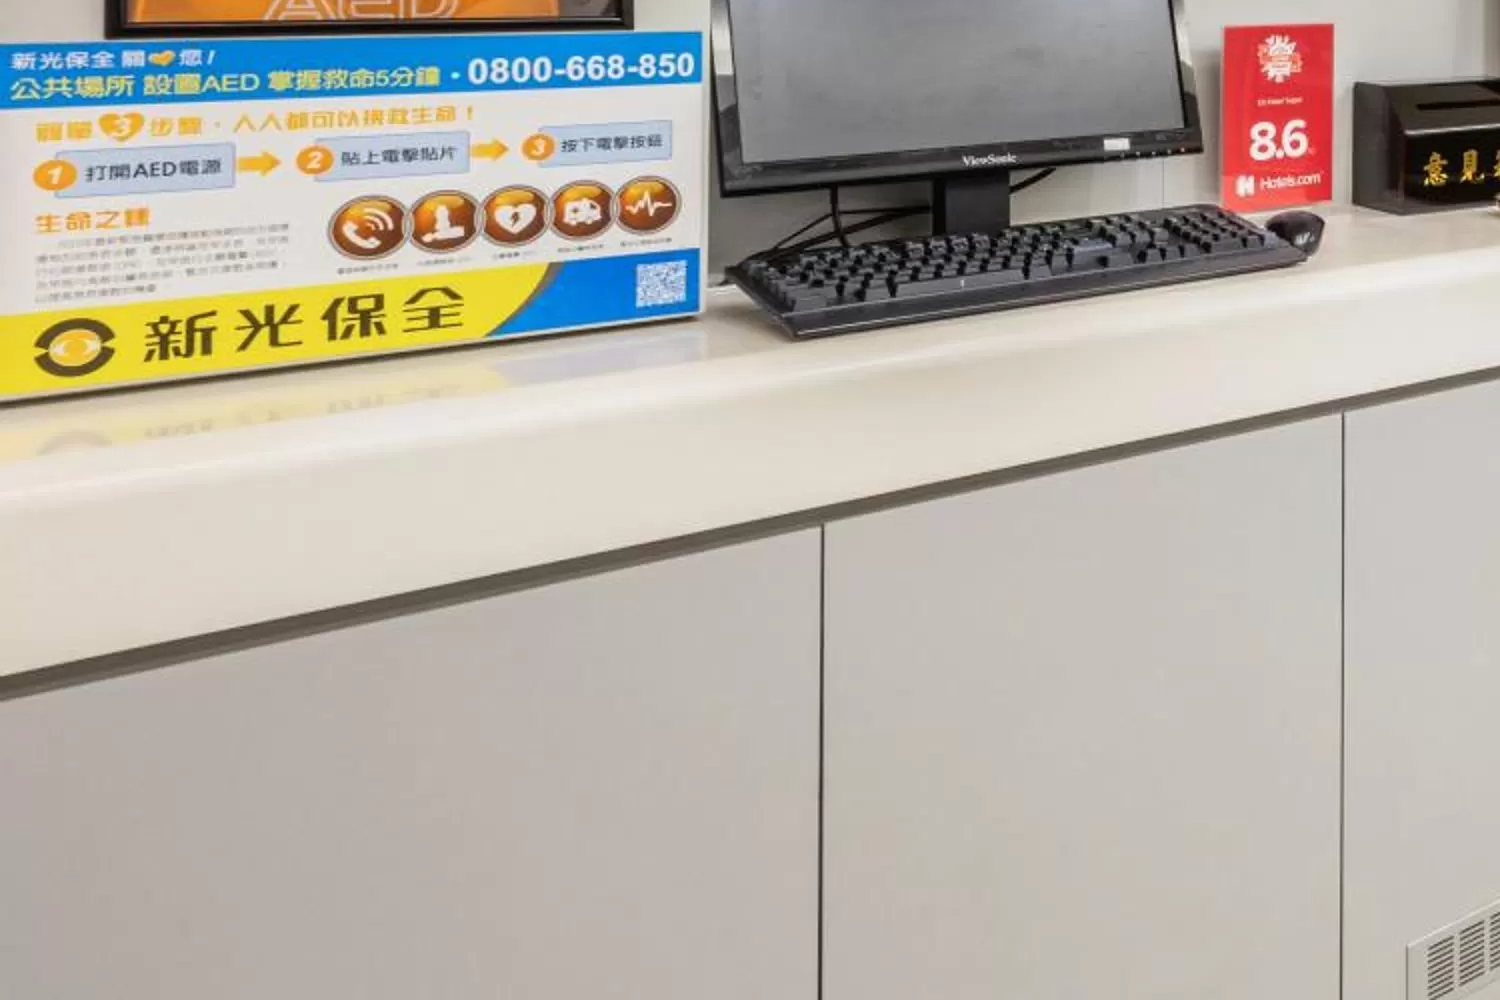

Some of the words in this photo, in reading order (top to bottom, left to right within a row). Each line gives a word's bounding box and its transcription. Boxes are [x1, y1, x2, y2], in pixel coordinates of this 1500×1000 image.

[10, 50, 116, 71] 新光保全
[467, 52, 695, 85] 0800-668-850
[9, 74, 135, 100] 公共場所
[1248, 118, 1309, 162] 8.6
[84, 158, 222, 183] 打開AED電源
[1259, 171, 1322, 191] Hotels.com
[143, 286, 465, 363] 新光保全
